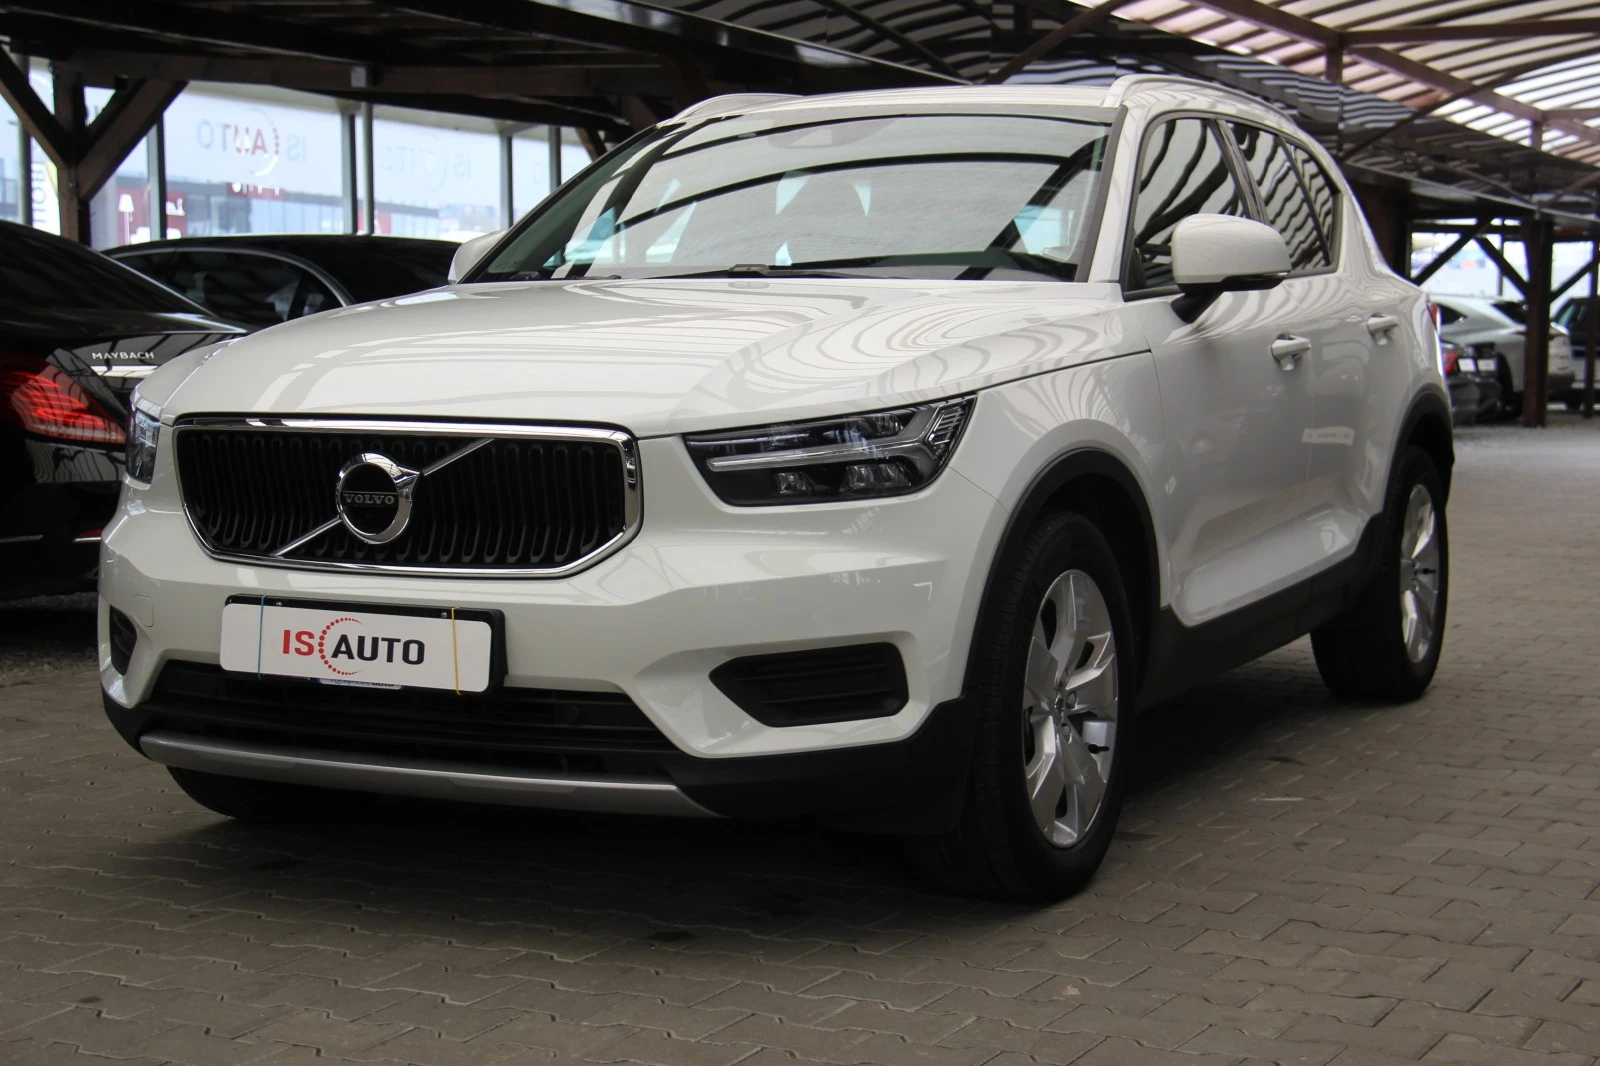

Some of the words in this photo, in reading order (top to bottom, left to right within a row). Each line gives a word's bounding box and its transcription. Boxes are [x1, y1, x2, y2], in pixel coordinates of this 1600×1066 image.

[92, 351, 154, 360] MAYBACH
[343, 494, 394, 505] VOLVO
[282, 629, 315, 656] IS
[331, 634, 425, 665] AUTO
